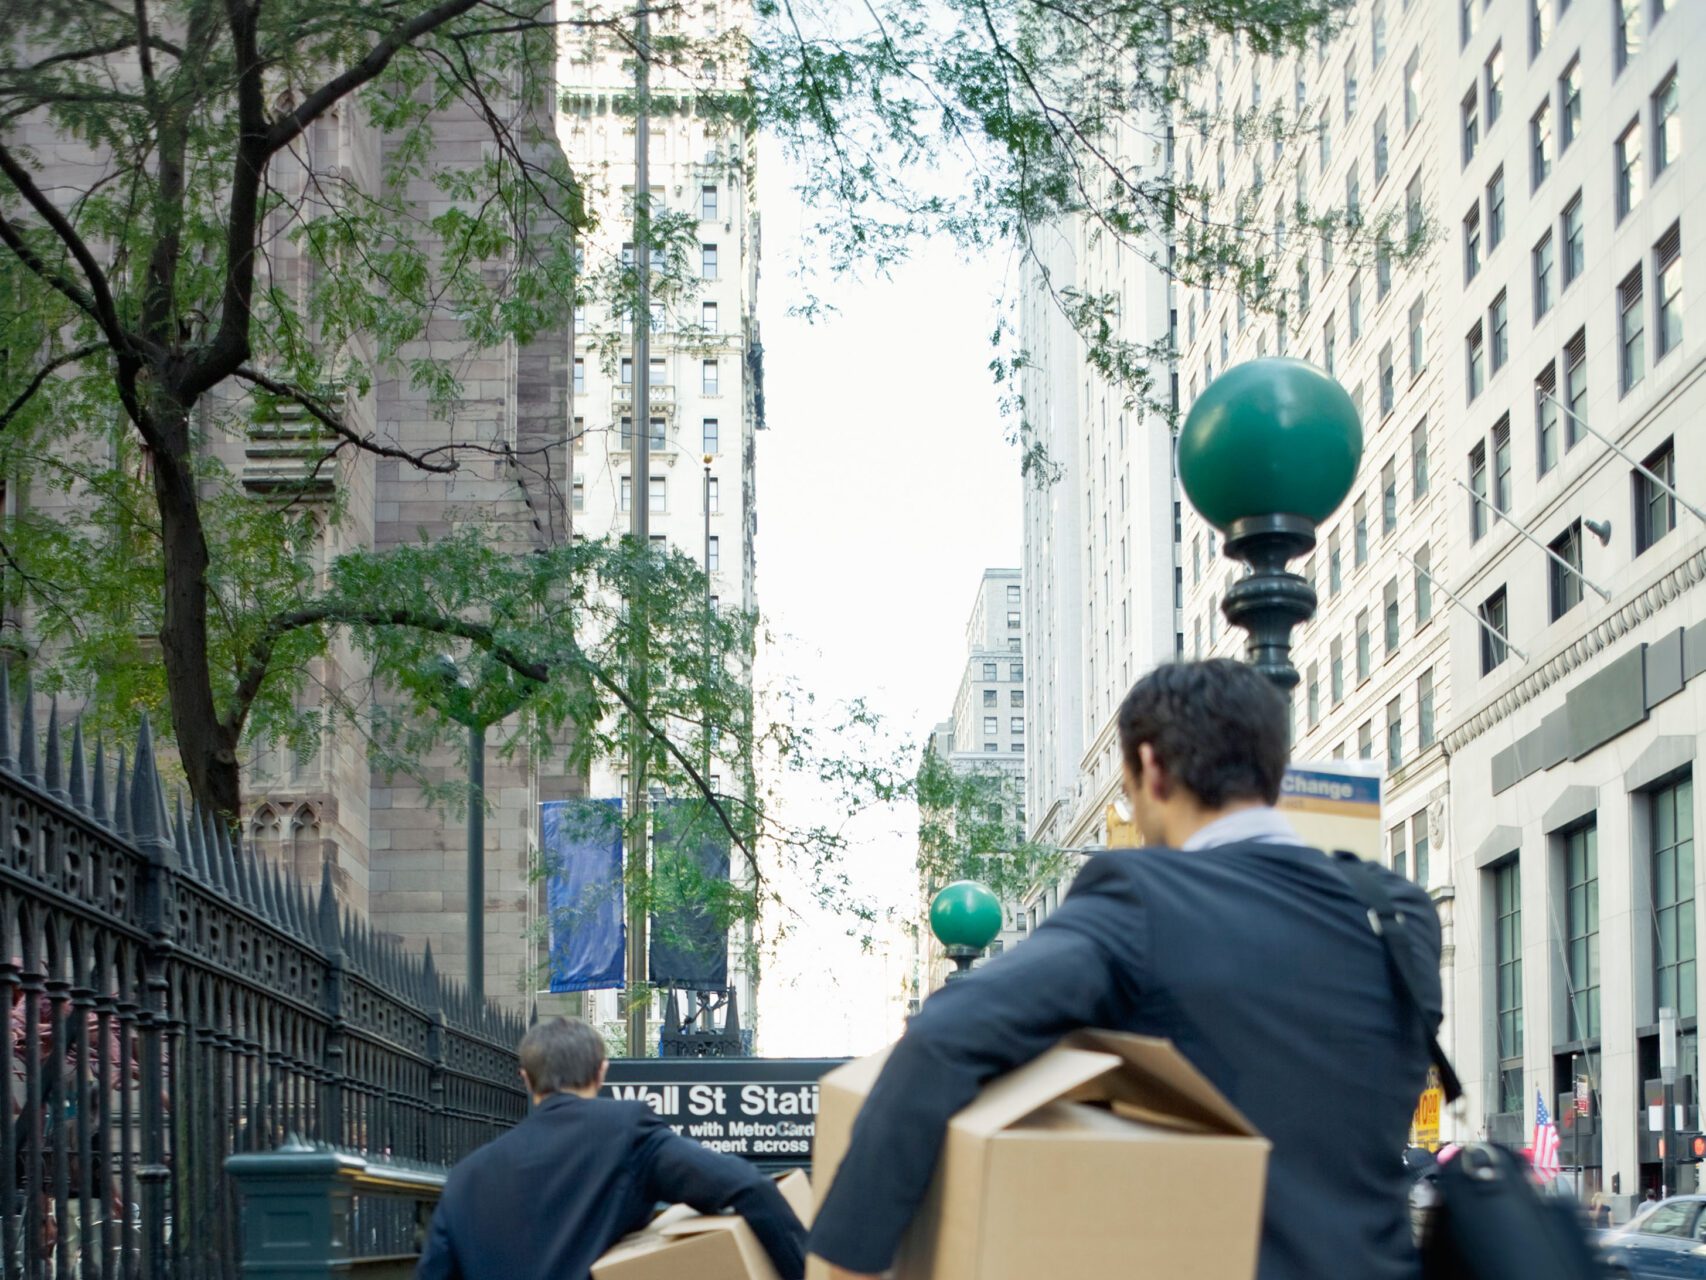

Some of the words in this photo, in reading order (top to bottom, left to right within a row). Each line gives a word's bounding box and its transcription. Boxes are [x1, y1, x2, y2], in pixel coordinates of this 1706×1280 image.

[688, 1085, 727, 1115] St
[689, 1121, 724, 1137] with
[729, 1121, 815, 1137] MetroCard
[753, 1139, 809, 1152] across
